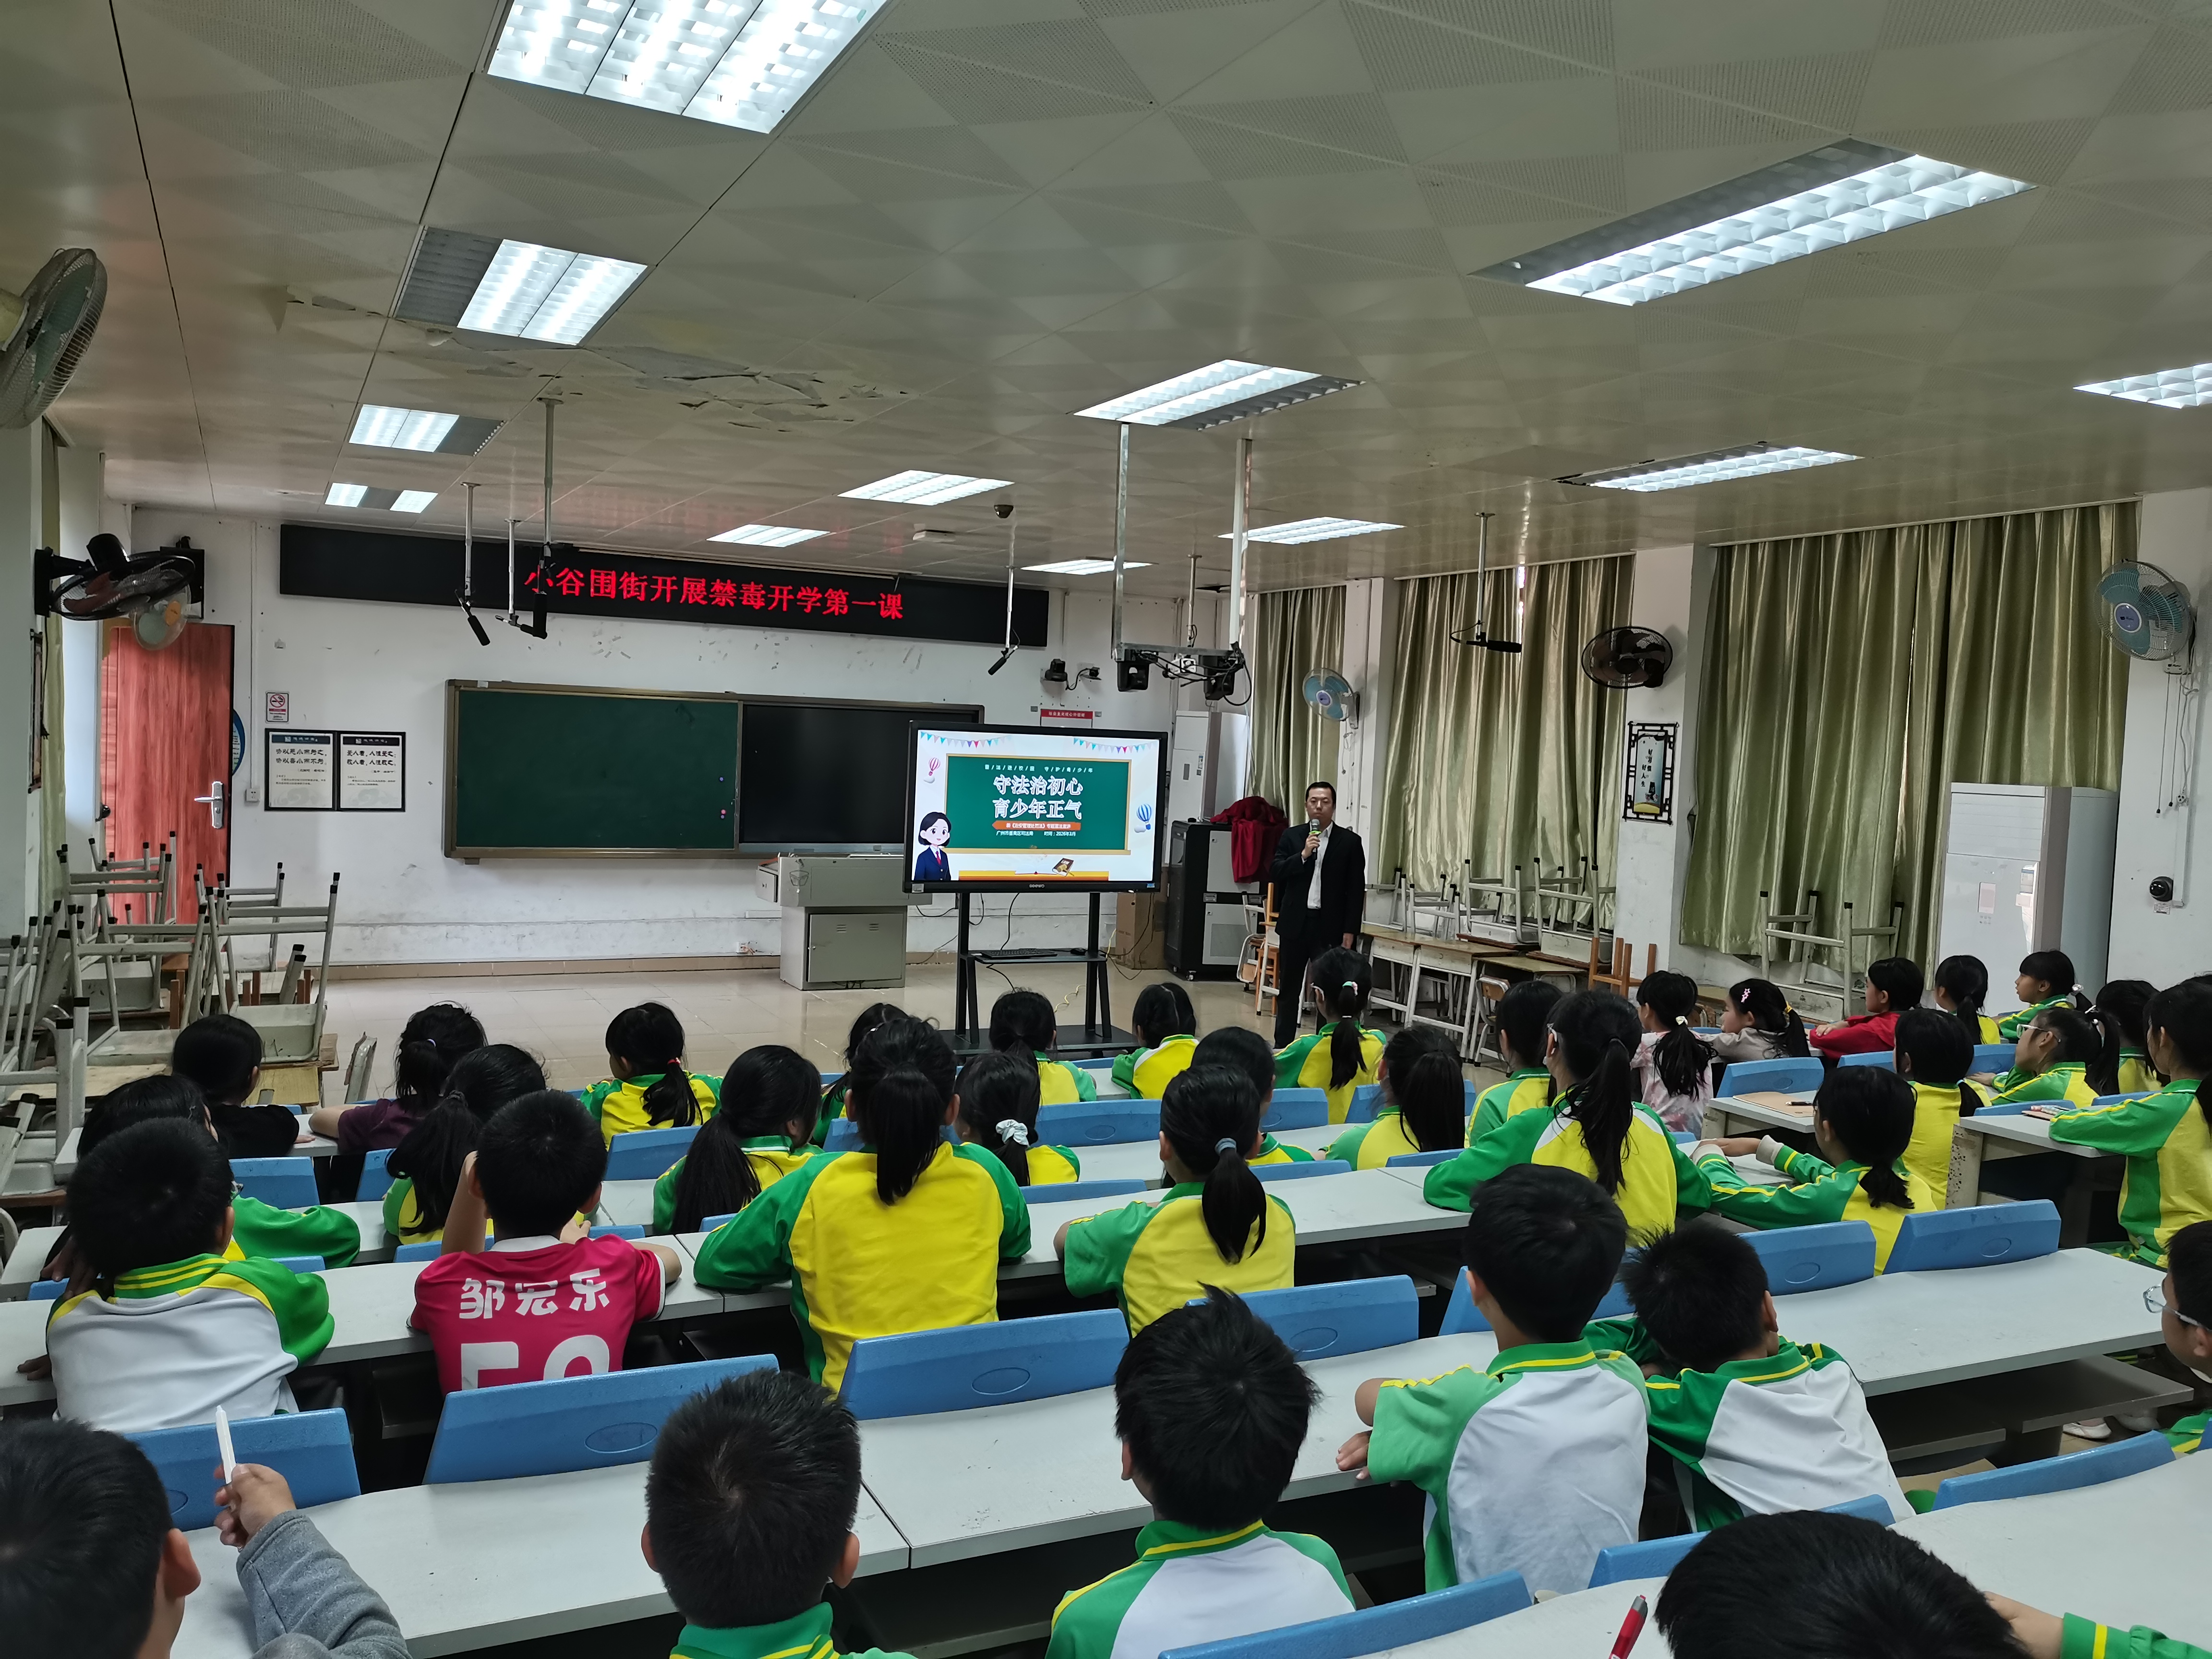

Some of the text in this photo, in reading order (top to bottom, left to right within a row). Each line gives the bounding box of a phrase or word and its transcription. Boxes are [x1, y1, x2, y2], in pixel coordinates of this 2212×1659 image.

[524, 564, 903, 620] 小谷围街开展禁毒开学第一课
[993, 773, 1083, 796] 守法治初心
[992, 797, 1082, 820] 育少年正气
[459, 1268, 610, 1319] 邹宏乐
